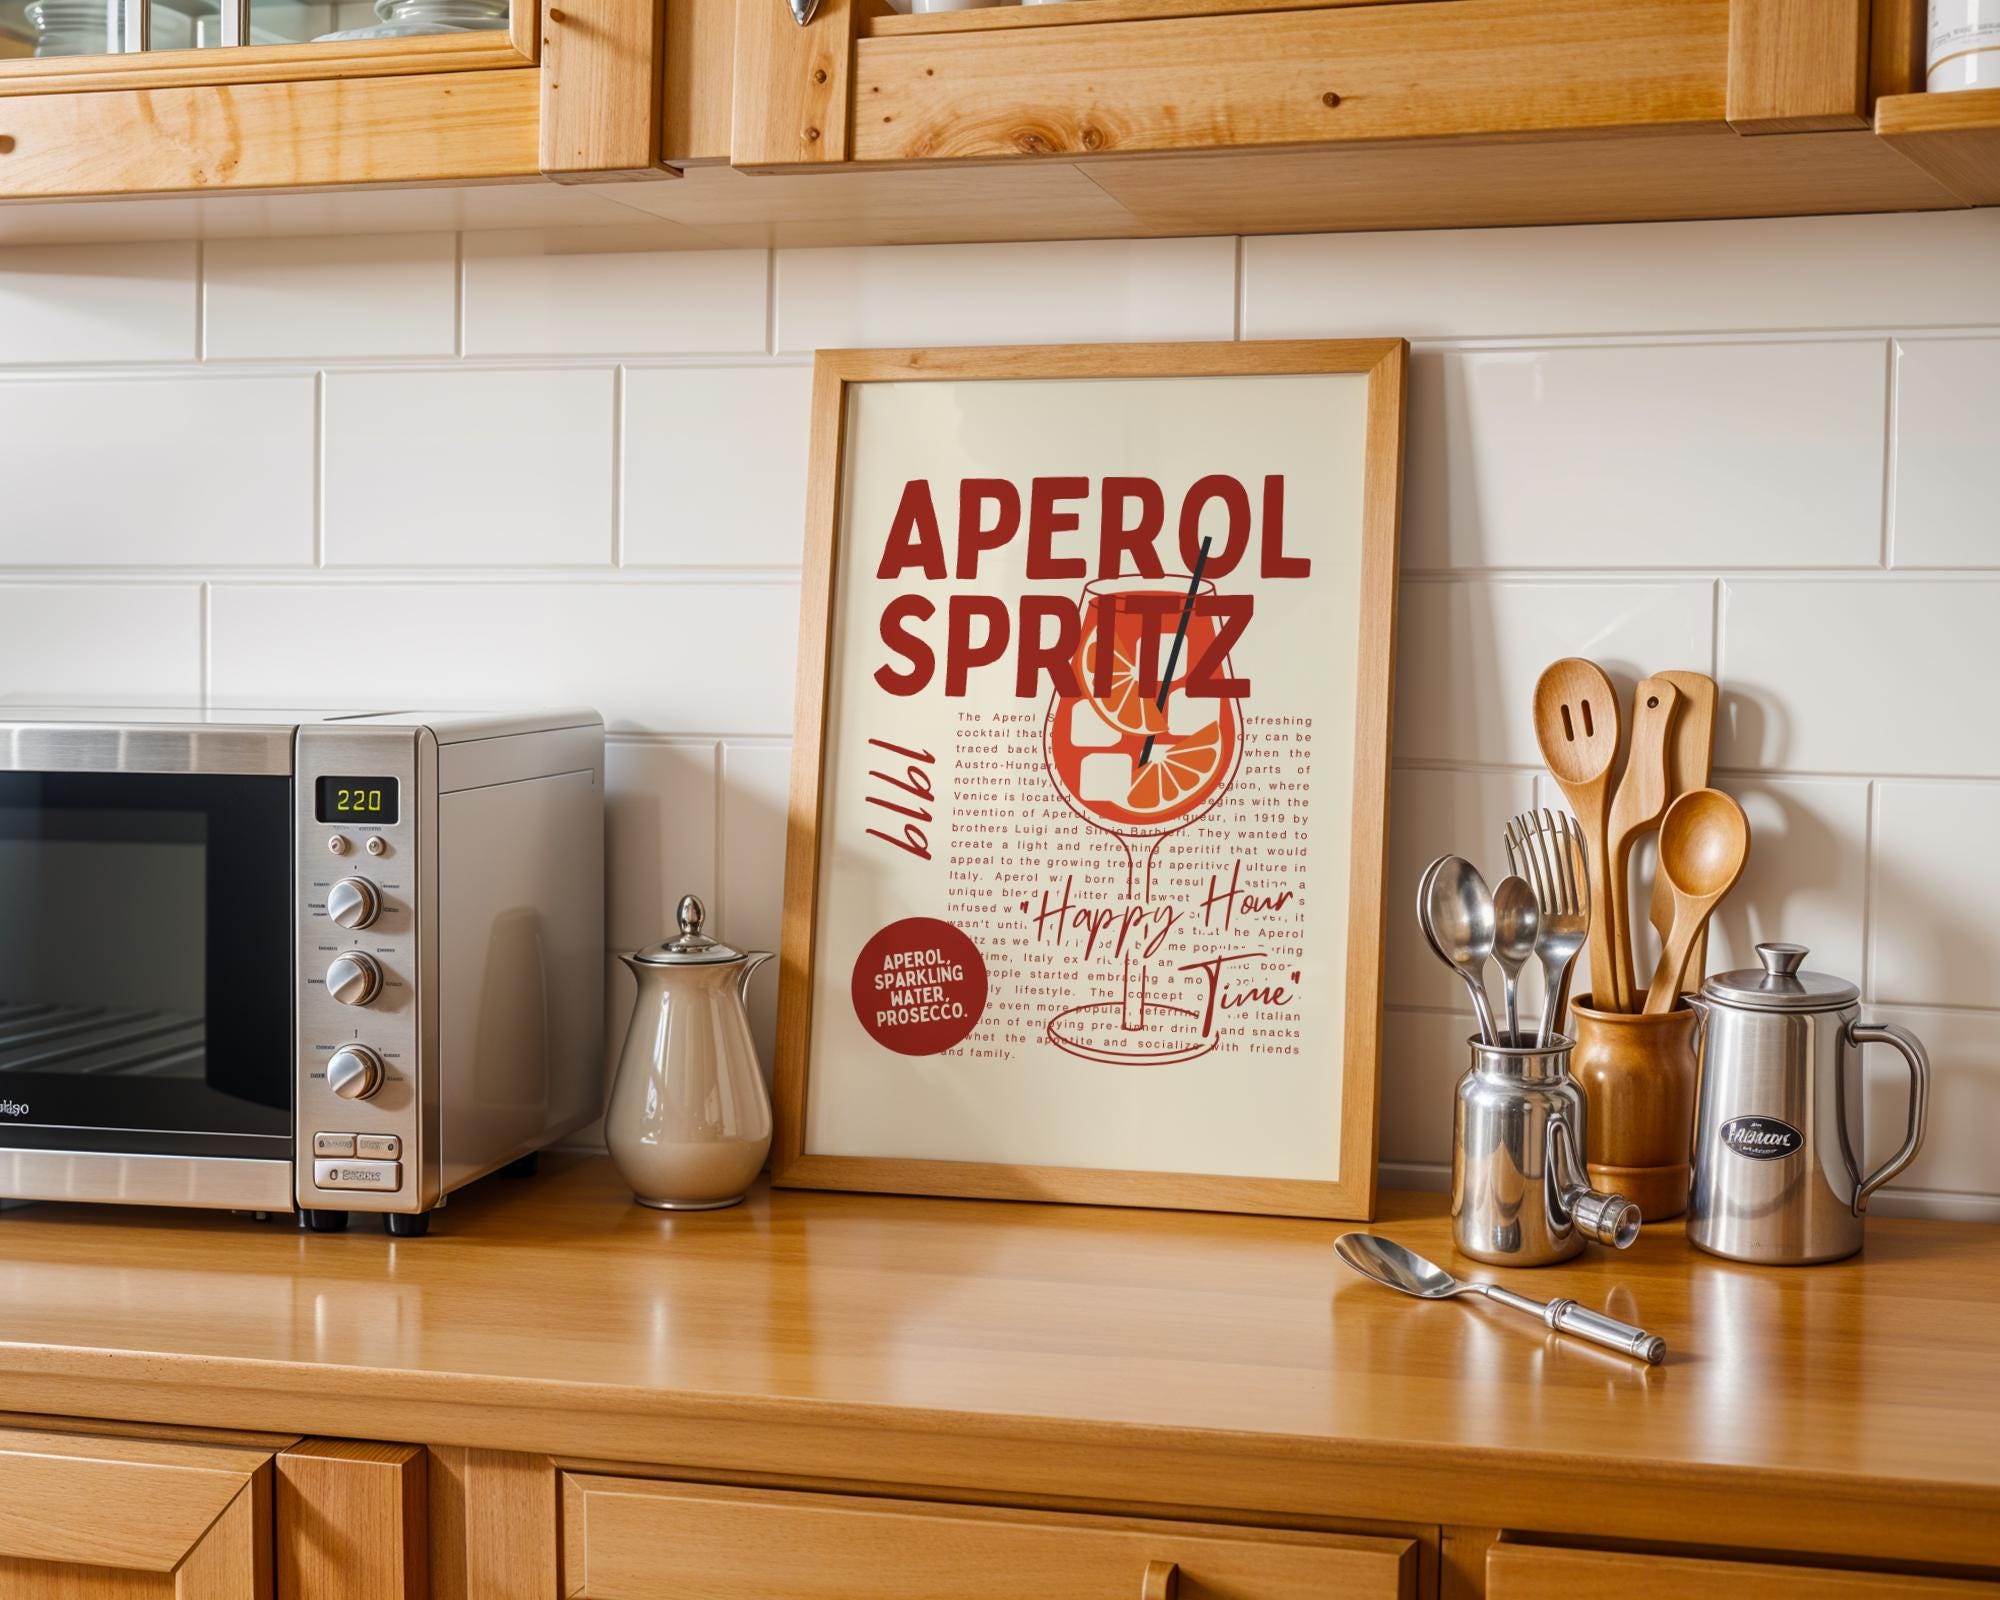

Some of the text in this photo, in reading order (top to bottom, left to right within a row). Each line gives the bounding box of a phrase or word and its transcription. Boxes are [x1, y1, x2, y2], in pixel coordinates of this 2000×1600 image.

[876, 474, 1312, 580] APEROL
[873, 594, 1255, 699] SPRITZ
[958, 712, 981, 722] The
[993, 712, 1036, 724] Aperol
[1243, 716, 1312, 727] efreshing
[957, 728, 1010, 738] cocktail
[1017, 729, 1043, 738] that
[1265, 733, 1289, 742] can
[1296, 733, 1312, 742] be
[956, 744, 998, 754] traced
[1008, 744, 1038, 754] back
[1245, 749, 1279, 758] when
[1290, 750, 1311, 758] the
[1245, 766, 1281, 775] parts
[1297, 766, 1311, 774] of
[954, 776, 1011, 786] northern
[1219, 782, 1262, 792] egion,
[1269, 782, 1310, 791] where
[337, 789, 381, 811] 220
[865, 738, 936, 861] 1919
[954, 791, 998, 801] Venice
[1004, 792, 1015, 801] is
[1021, 793, 1071, 803] located
[1252, 797, 1280, 806] with
[1287, 798, 1309, 807] the
[953, 808, 1015, 817] invention
[1022, 809, 1035, 818] of
[1234, 813, 1246, 822] in
[1255, 814, 1285, 823] 1919
[1293, 815, 1309, 825] by
[951, 824, 1009, 833] brothers
[1015, 825, 1048, 836] Luigi
[1054, 826, 1079, 835] and
[1198, 829, 1231, 840] They
[1238, 830, 1287, 839] wanted
[1295, 831, 1308, 840] to
[951, 840, 993, 849] create
[1002, 842, 1009, 850] a
[1017, 840, 1048, 852] light
[1057, 841, 1081, 851] and
[1169, 845, 1221, 855] aperitif
[1230, 846, 1258, 855] that
[1267, 847, 1307, 857] would
[950, 855, 994, 866] appeal
[1001, 856, 1014, 865] to
[1020, 857, 1041, 866] the
[1047, 859, 1100, 870] growing
[1246, 863, 1288, 873] ulture
[1294, 863, 1307, 873] in
[995, 872, 1039, 884] Aperol
[1084, 874, 1115, 884] born
[1152, 878, 1159, 886] a
[1299, 881, 1306, 889] a
[949, 887, 993, 899] unique
[1199, 858, 1294, 931] Hour
[948, 902, 997, 913] infused
[1258, 927, 1304, 939] Aperol
[992, 937, 1007, 946] as
[1012, 937, 1030, 946] we
[883, 948, 951, 971] APEROL,
[1024, 953, 1054, 965] Italy
[874, 965, 964, 991] SPARKLING
[986, 969, 1022, 980] eople
[1030, 970, 1079, 981] started
[1168, 976, 1175, 984] a
[890, 986, 950, 1007] WATER,
[1090, 987, 1114, 998] The
[1128, 991, 1183, 1002] concept
[876, 1002, 968, 1028] PROSECCO.
[999, 1002, 1030, 1011] even
[1036, 1003, 1069, 1012] more
[1256, 1011, 1301, 1022] Italian
[1007, 1018, 1020, 1027] of
[1220, 1026, 1245, 1036] and
[1252, 1028, 1300, 1038] snacks
[1005, 1034, 1027, 1043] the
[1103, 1037, 1128, 1047] and
[1211, 1042, 1239, 1052] with
[1249, 1043, 1300, 1055] friends
